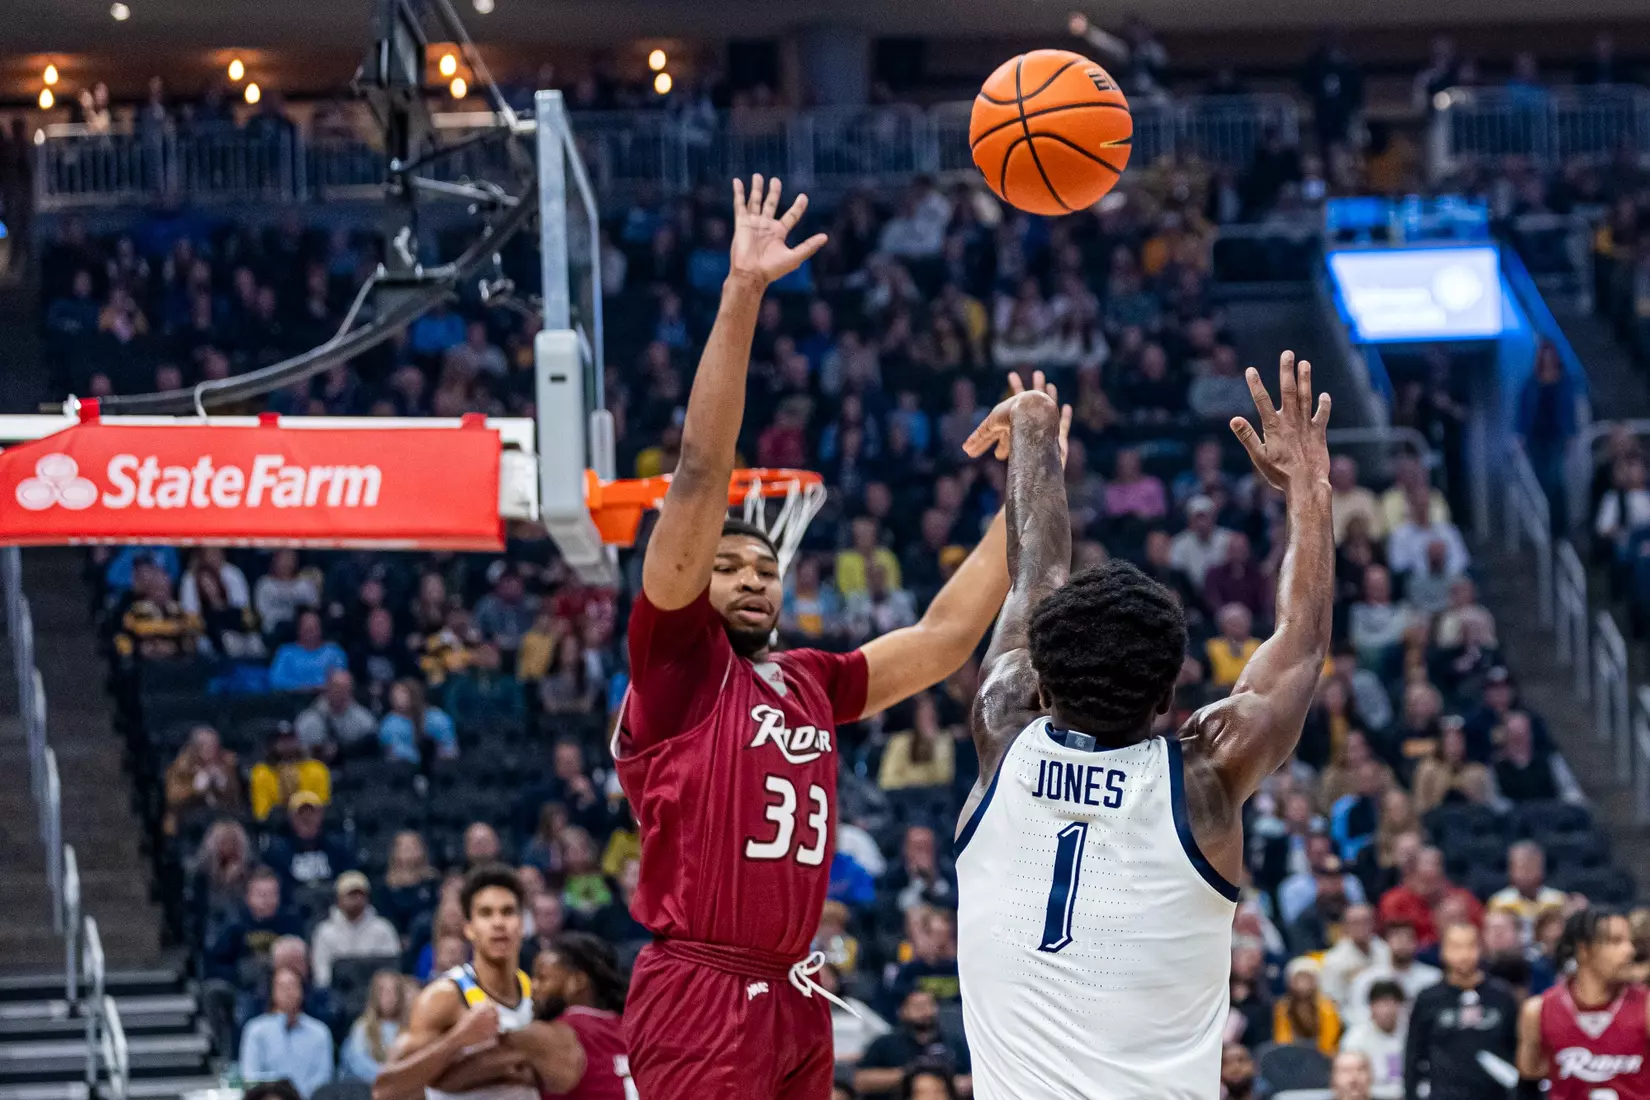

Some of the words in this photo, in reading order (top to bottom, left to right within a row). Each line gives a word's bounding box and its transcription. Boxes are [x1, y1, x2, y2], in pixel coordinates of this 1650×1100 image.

[745, 775, 829, 866] 33
[1031, 759, 1127, 810] JONES
[1037, 820, 1090, 953] 1
